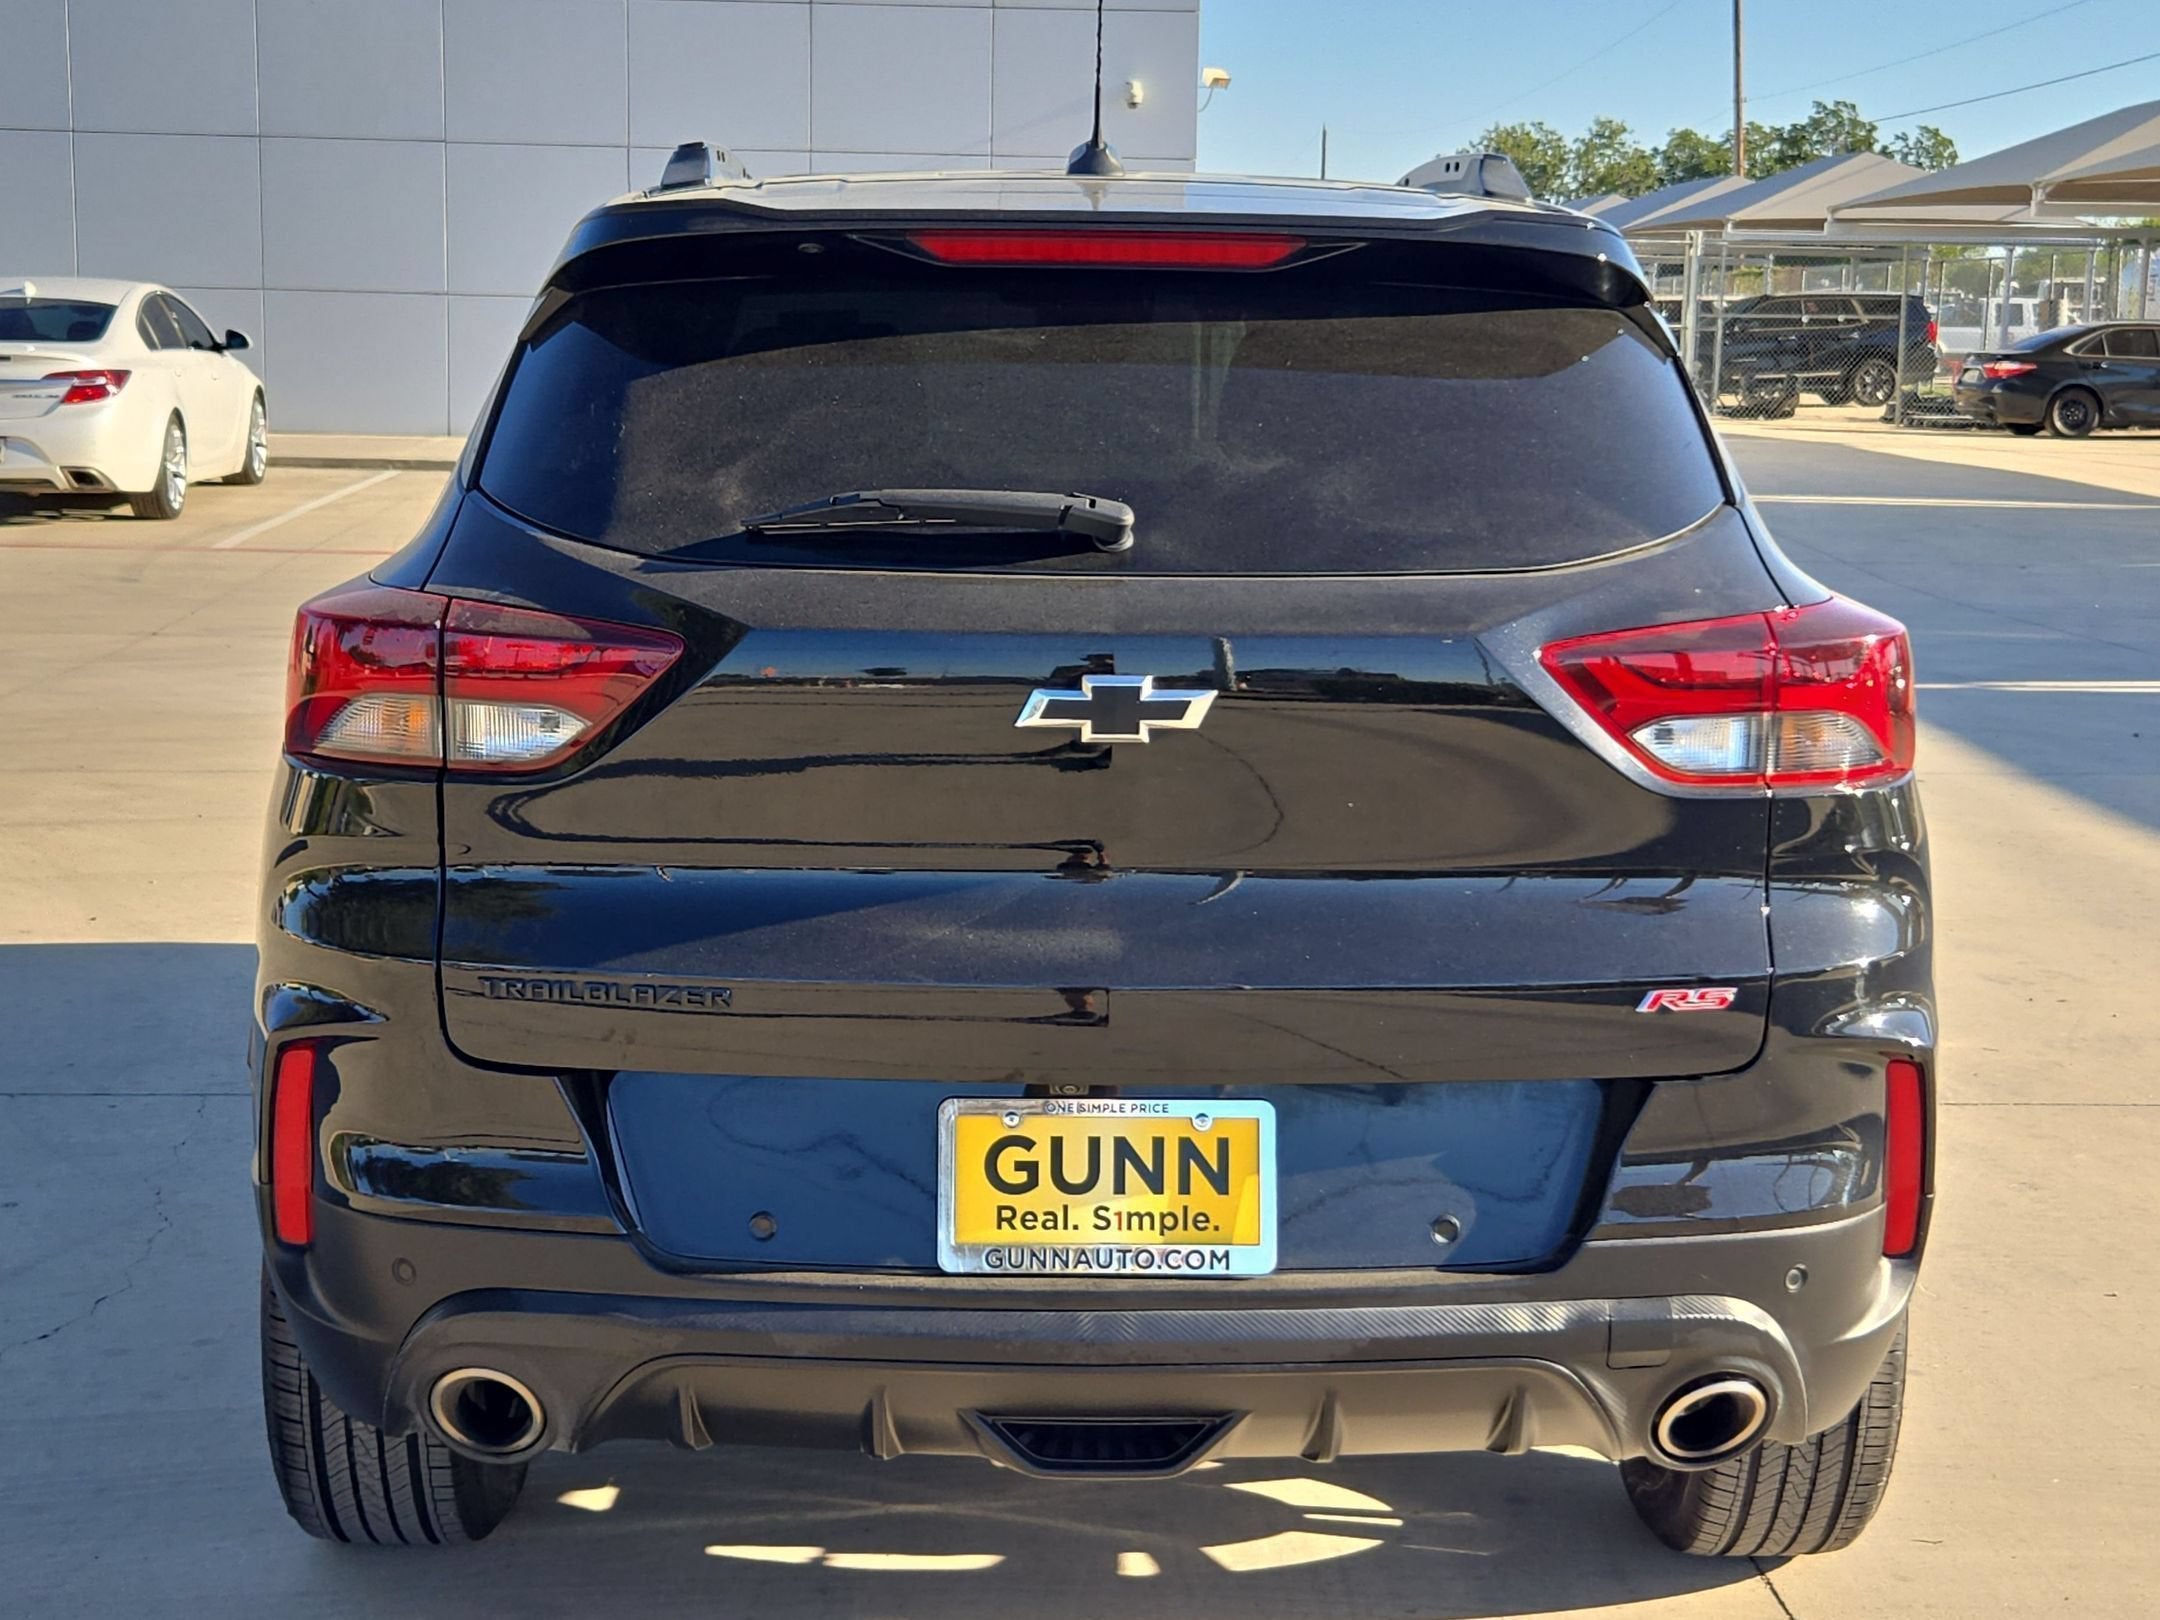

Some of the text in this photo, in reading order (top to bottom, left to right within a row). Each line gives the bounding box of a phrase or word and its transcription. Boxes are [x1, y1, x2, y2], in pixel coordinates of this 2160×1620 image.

[478, 976, 733, 1008] TRAILBLAZER
[1635, 987, 1738, 1013] RS
[1045, 1102, 1169, 1113] ONE SIMPLE PRICE
[984, 1135, 1230, 1195] GUNN
[996, 1204, 1079, 1231] Real.
[985, 1249, 1230, 1270] GUNNAUTO.COM
